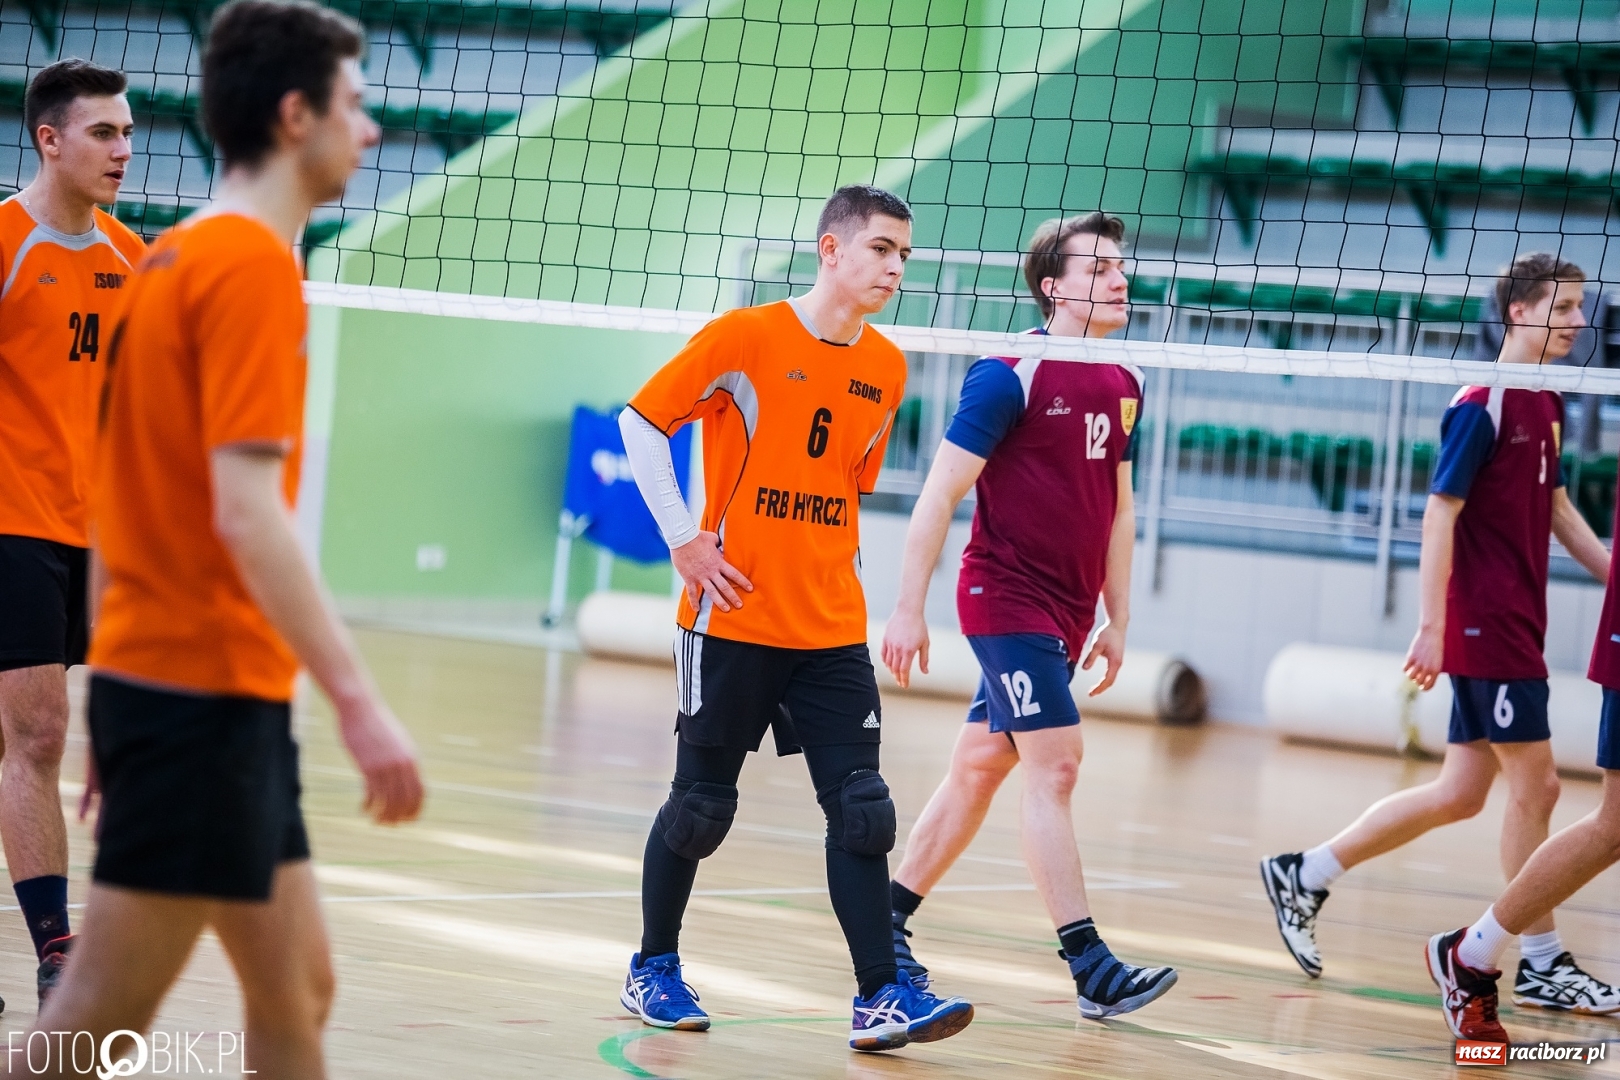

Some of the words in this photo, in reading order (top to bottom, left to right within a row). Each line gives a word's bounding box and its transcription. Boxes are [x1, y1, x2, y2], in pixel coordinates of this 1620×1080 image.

[68, 311, 99, 362] 24
[848, 378, 883, 404] ZSOMS
[807, 407, 833, 459] 6
[1084, 412, 1111, 460] 12
[755, 486, 790, 519] FRB
[1000, 670, 1041, 718] 12
[1493, 683, 1514, 728] 6
